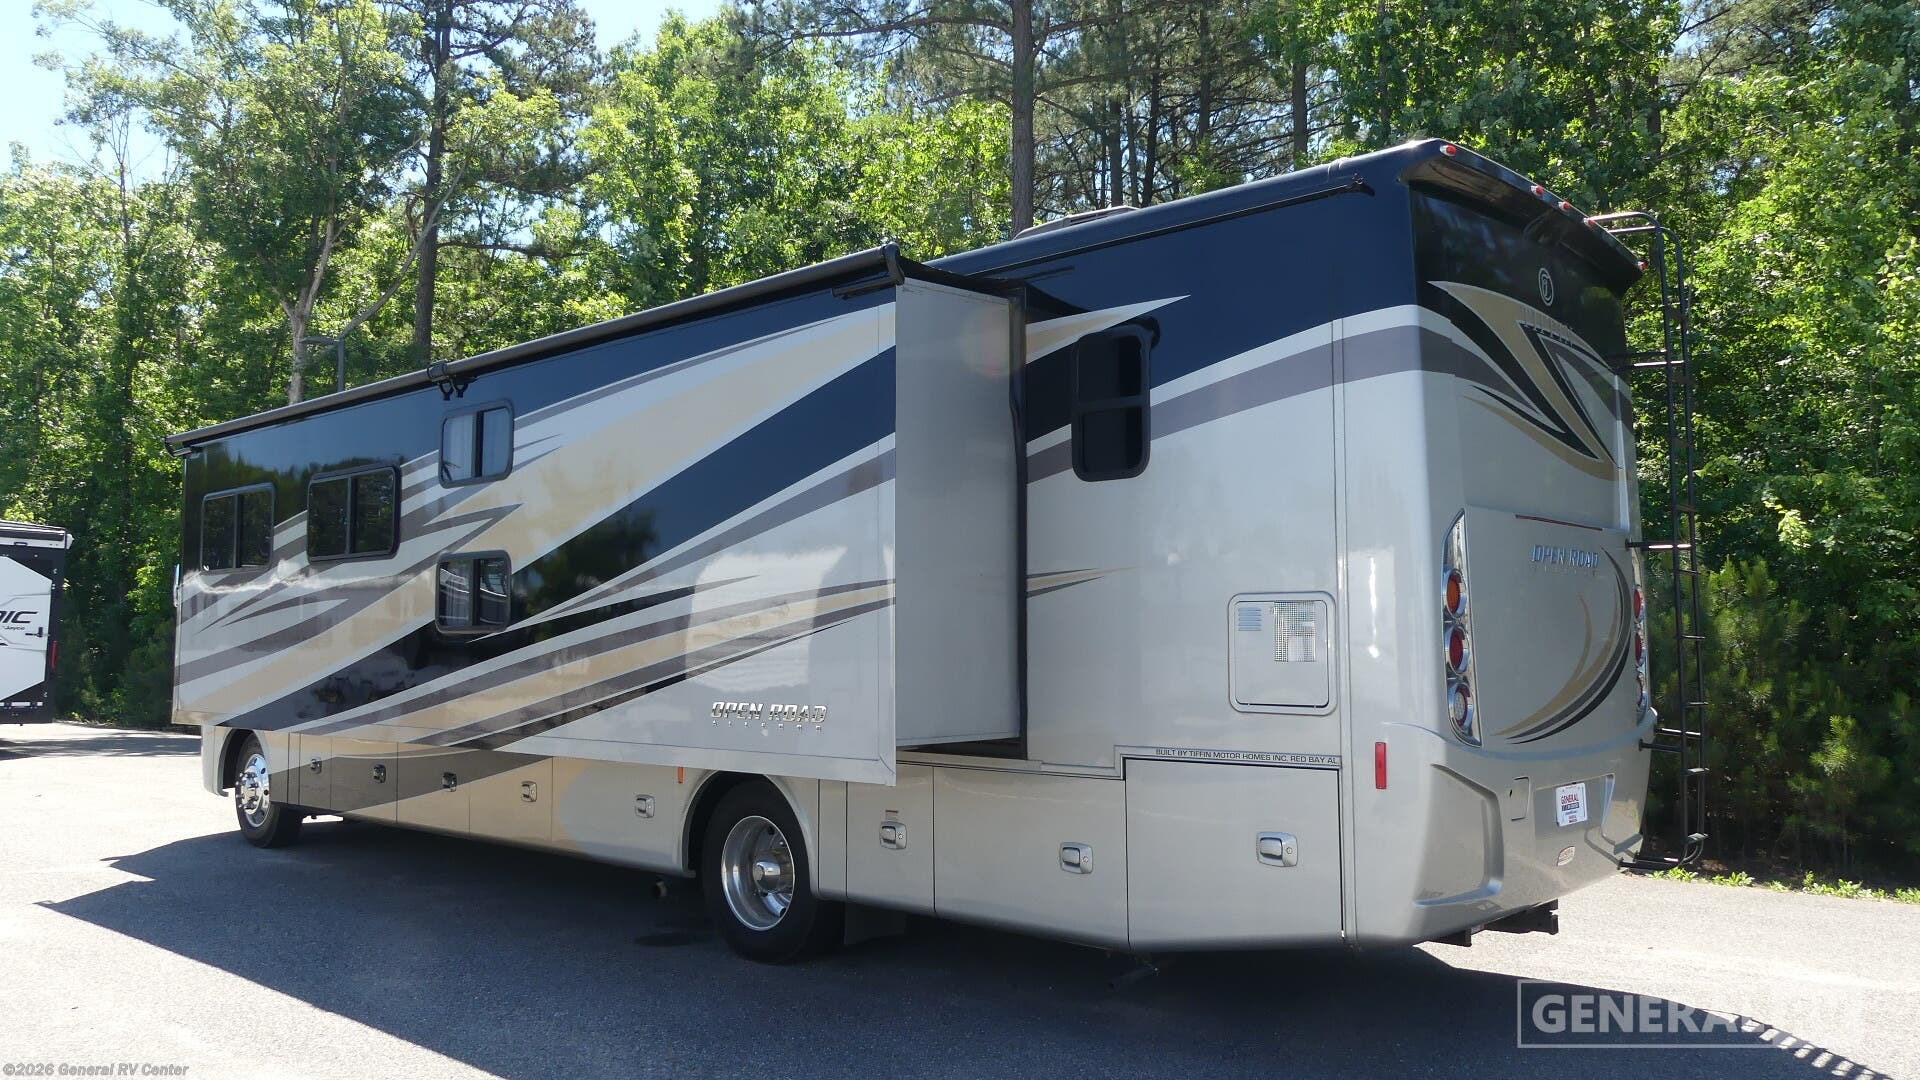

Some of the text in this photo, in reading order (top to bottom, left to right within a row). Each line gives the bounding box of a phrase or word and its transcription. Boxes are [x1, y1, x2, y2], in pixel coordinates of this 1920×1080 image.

[1531, 544, 1599, 569] OPEN ROAD
[711, 701, 827, 723] OPEN ROAD
[1155, 749, 1175, 757] BUILT
[1189, 750, 1212, 758] TIFFIN
[1213, 752, 1241, 760] MOTOR
[1242, 753, 1271, 761] HOMES
[1290, 755, 1307, 763] RED
